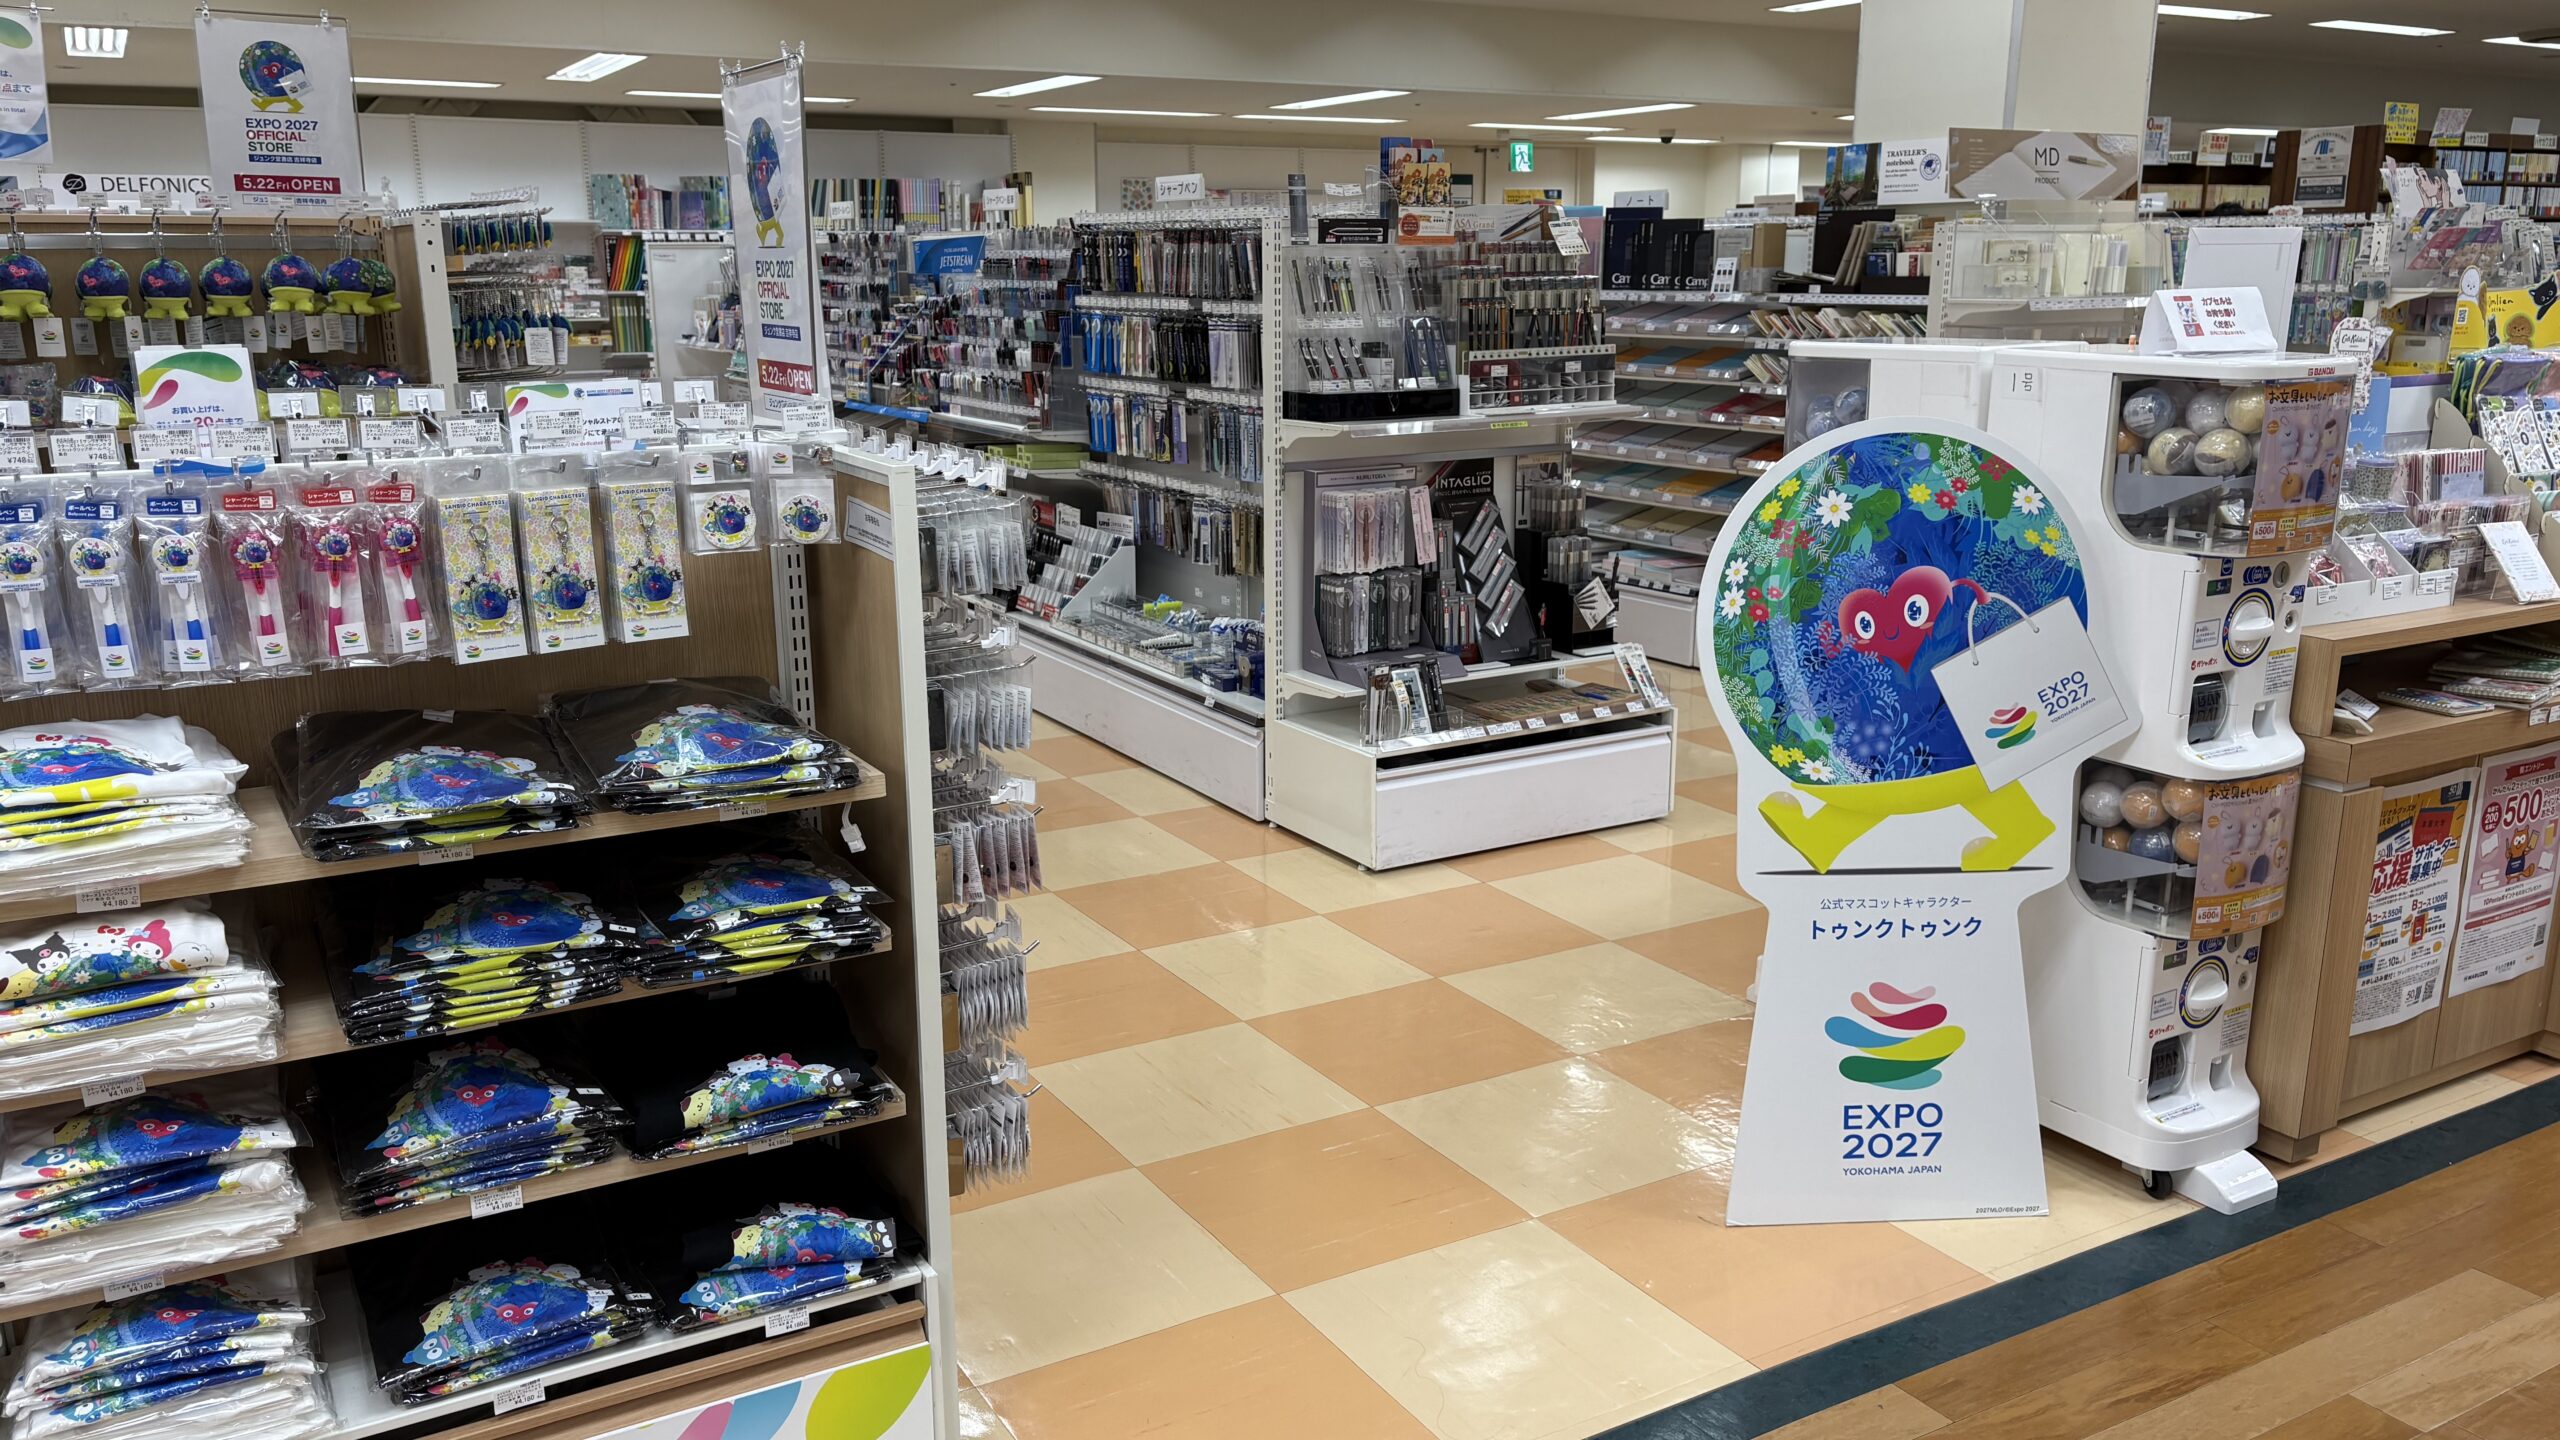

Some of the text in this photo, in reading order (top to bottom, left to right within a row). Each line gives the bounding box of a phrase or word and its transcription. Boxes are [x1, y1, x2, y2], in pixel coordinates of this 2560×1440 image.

[246, 118, 318, 131] EXPO 2027
[246, 130, 306, 142] OFFICIAL
[248, 142, 293, 152] STORE
[2035, 147, 2060, 166] MD
[100, 176, 212, 193] DELFONICS
[756, 261, 794, 278] EXPO 2027
[940, 254, 973, 268] JETSTREAM
[758, 281, 789, 300] OFFICIAL
[760, 301, 784, 320] STORE
[2314, 367, 2335, 375] BANDAI
[2012, 372, 2034, 393] 1号
[1435, 475, 1492, 489] INTAGLIO
[2037, 670, 2085, 703] EXPO
[2043, 682, 2089, 717] 2027
[2503, 788, 2543, 828] 500
[2371, 850, 2413, 895] 応援
[2410, 857, 2442, 882] 募集中
[1820, 895, 1973, 911] 公式マスコットキャラクター
[1811, 915, 1983, 941] トゥンクトゥンク
[1842, 1102, 1943, 1130] EXPO
[1841, 1131, 1943, 1159] 2027
[1842, 1164, 1942, 1177] YOKOHAMA JAPAN
